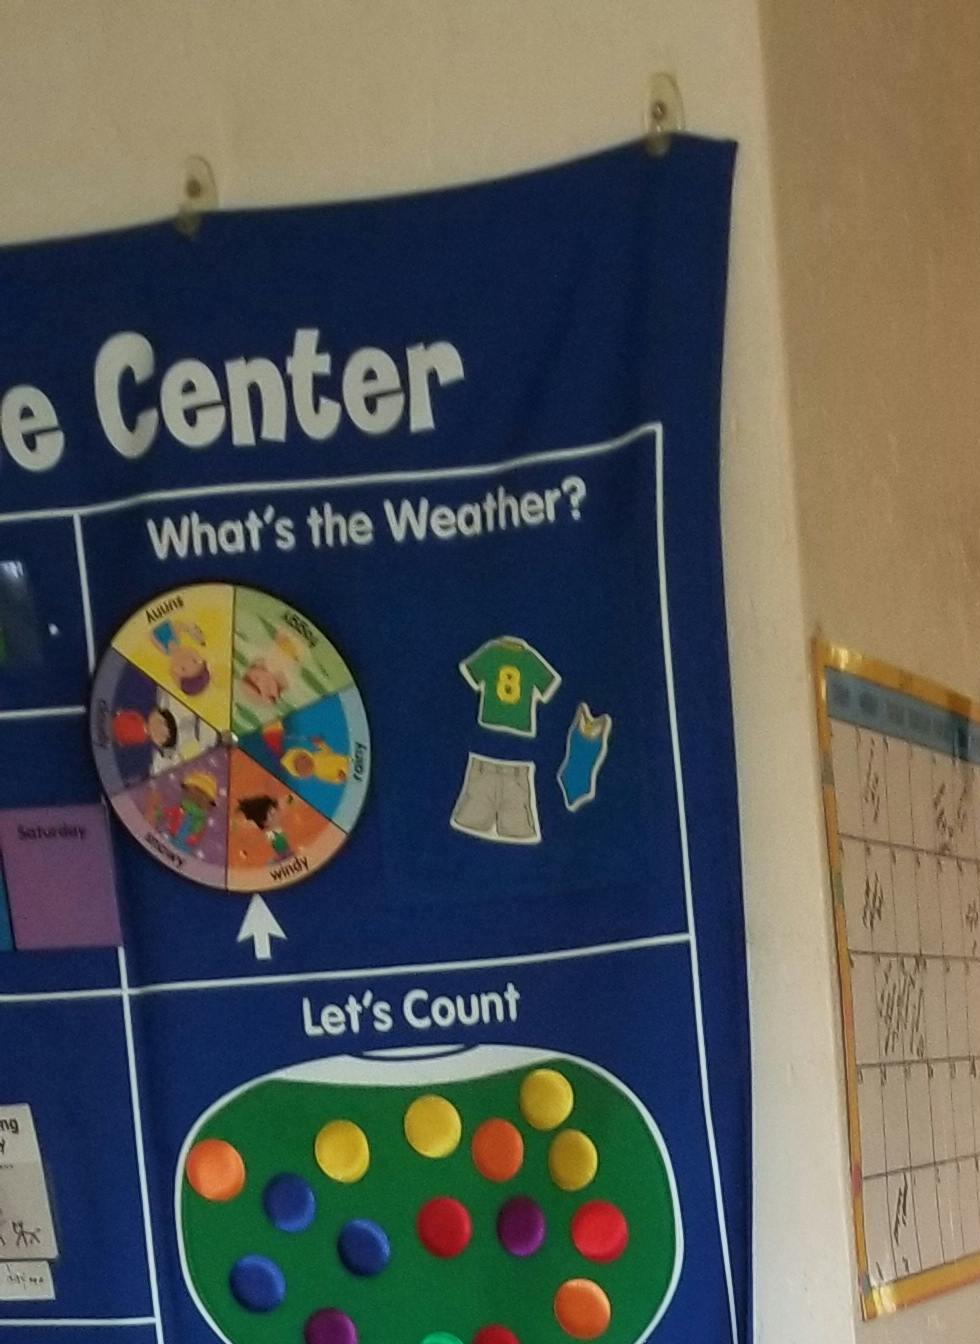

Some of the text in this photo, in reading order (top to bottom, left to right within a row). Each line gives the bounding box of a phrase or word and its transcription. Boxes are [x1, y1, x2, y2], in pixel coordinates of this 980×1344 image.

[94, 328, 466, 460] Center
[146, 476, 587, 561] What's the Weather?
[495, 665, 522, 704] 8
[16, 823, 87, 842] Saturday
[269, 855, 309, 882] windy
[302, 982, 520, 1036] Let's Count
